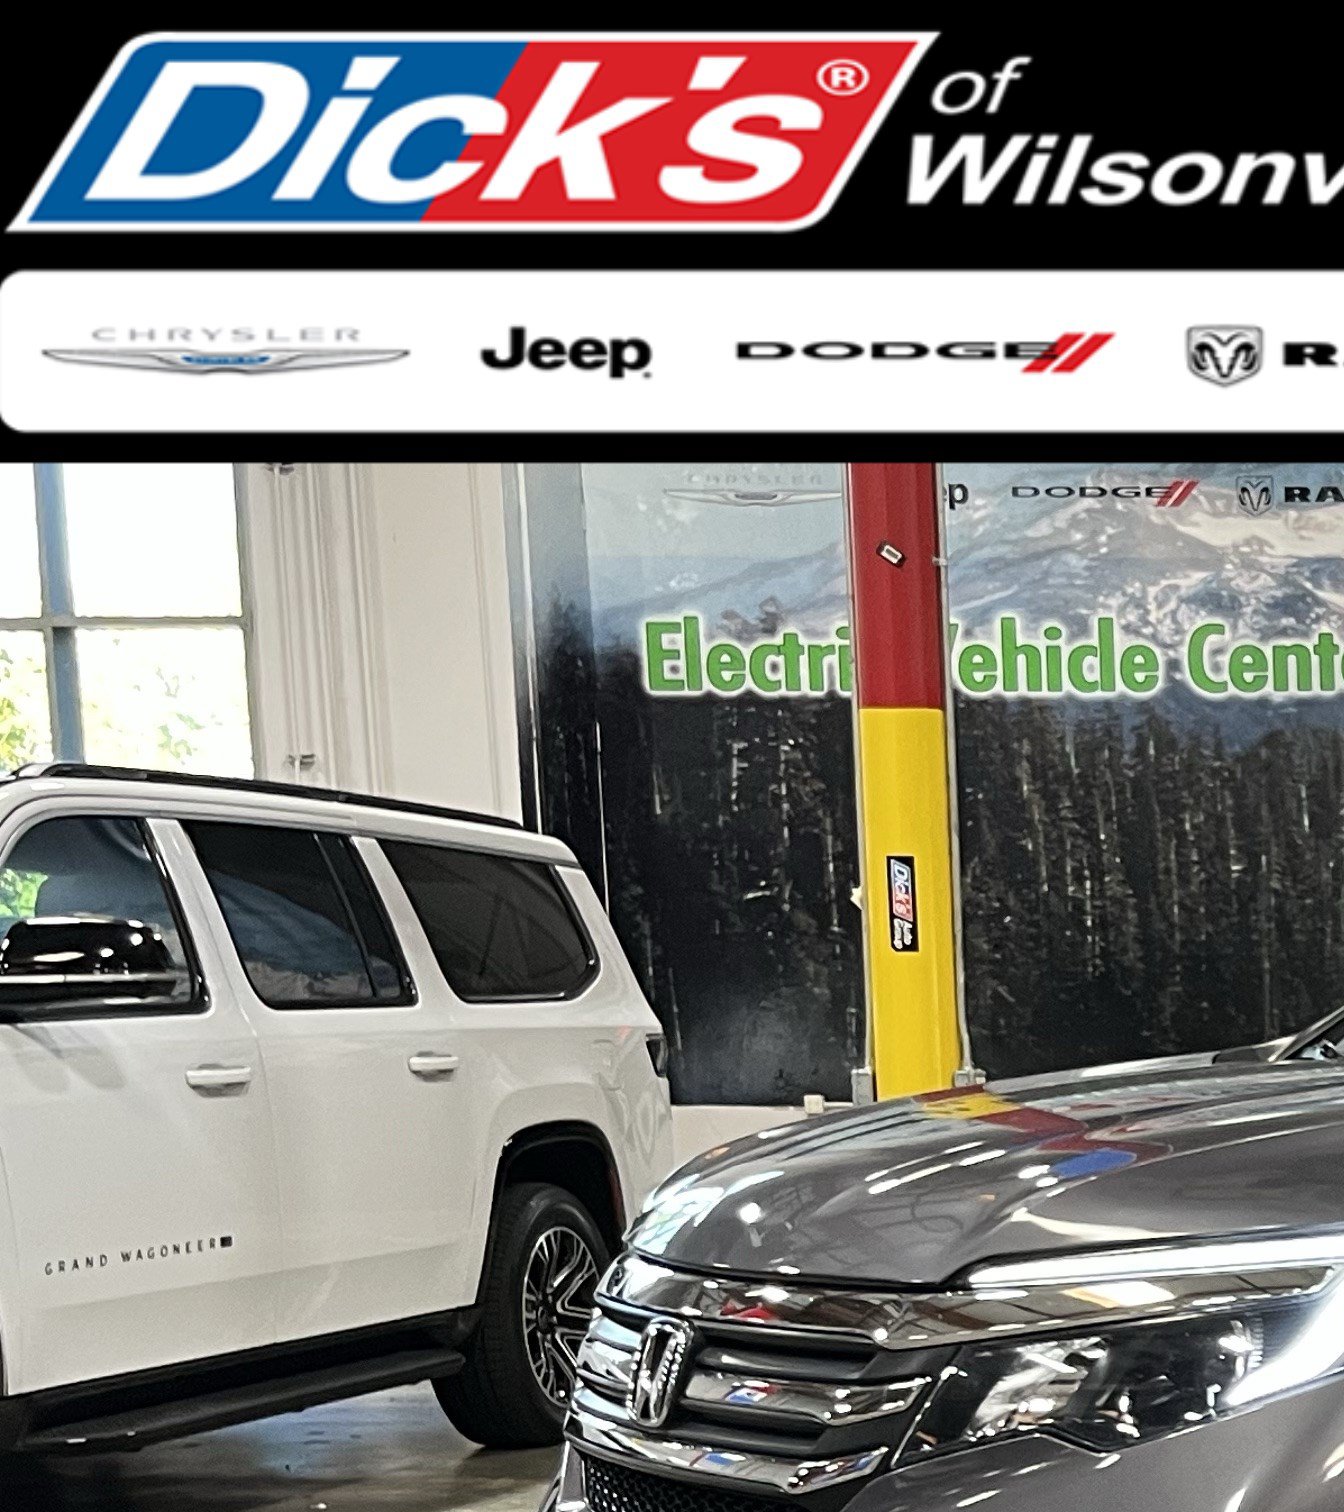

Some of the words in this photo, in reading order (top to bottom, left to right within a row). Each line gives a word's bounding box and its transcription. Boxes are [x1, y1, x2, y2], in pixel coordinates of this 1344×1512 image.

[1010, 485, 1172, 499] DODGE
[644, 615, 852, 693] Electri
[948, 616, 1160, 693] ehicle
[44, 1253, 108, 1276] GRAND
[120, 1236, 217, 1264] WAGONEER
